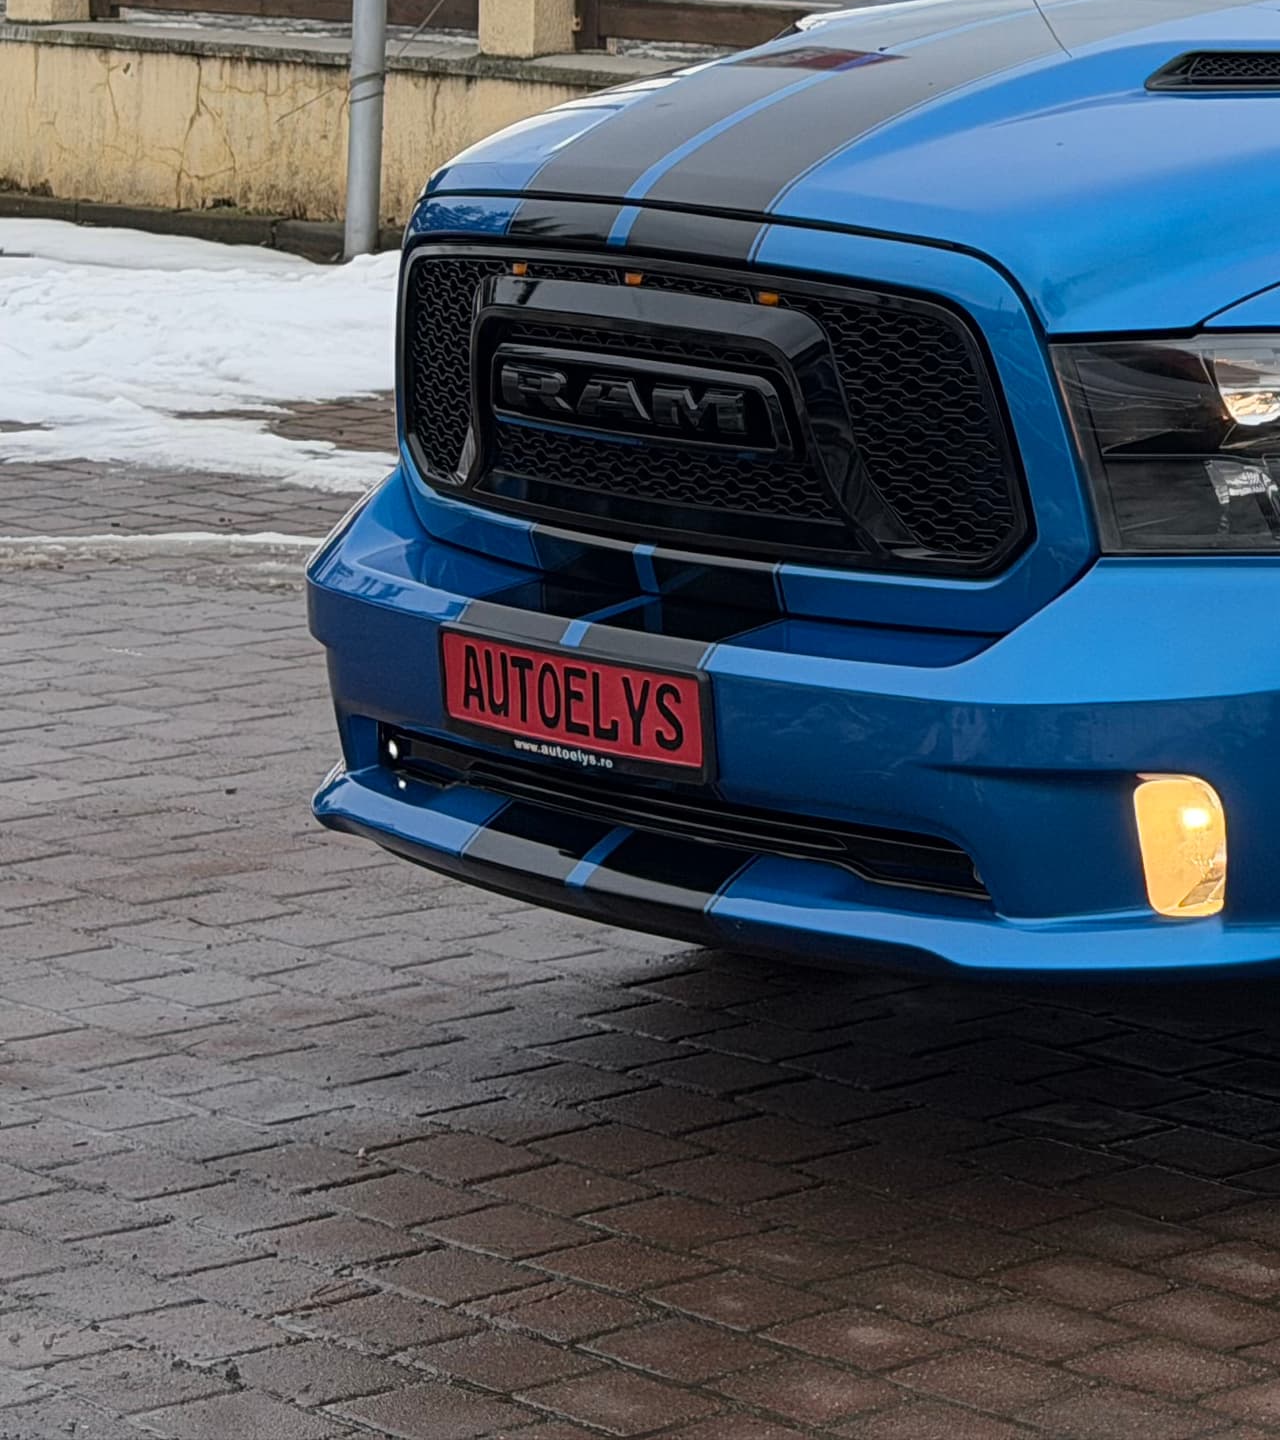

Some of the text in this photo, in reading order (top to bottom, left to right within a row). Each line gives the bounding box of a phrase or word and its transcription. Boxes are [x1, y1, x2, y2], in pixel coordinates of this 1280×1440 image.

[501, 362, 748, 435] RAM
[463, 644, 684, 751] AUTOELYS
[514, 738, 613, 769] www.autoelys.ro
